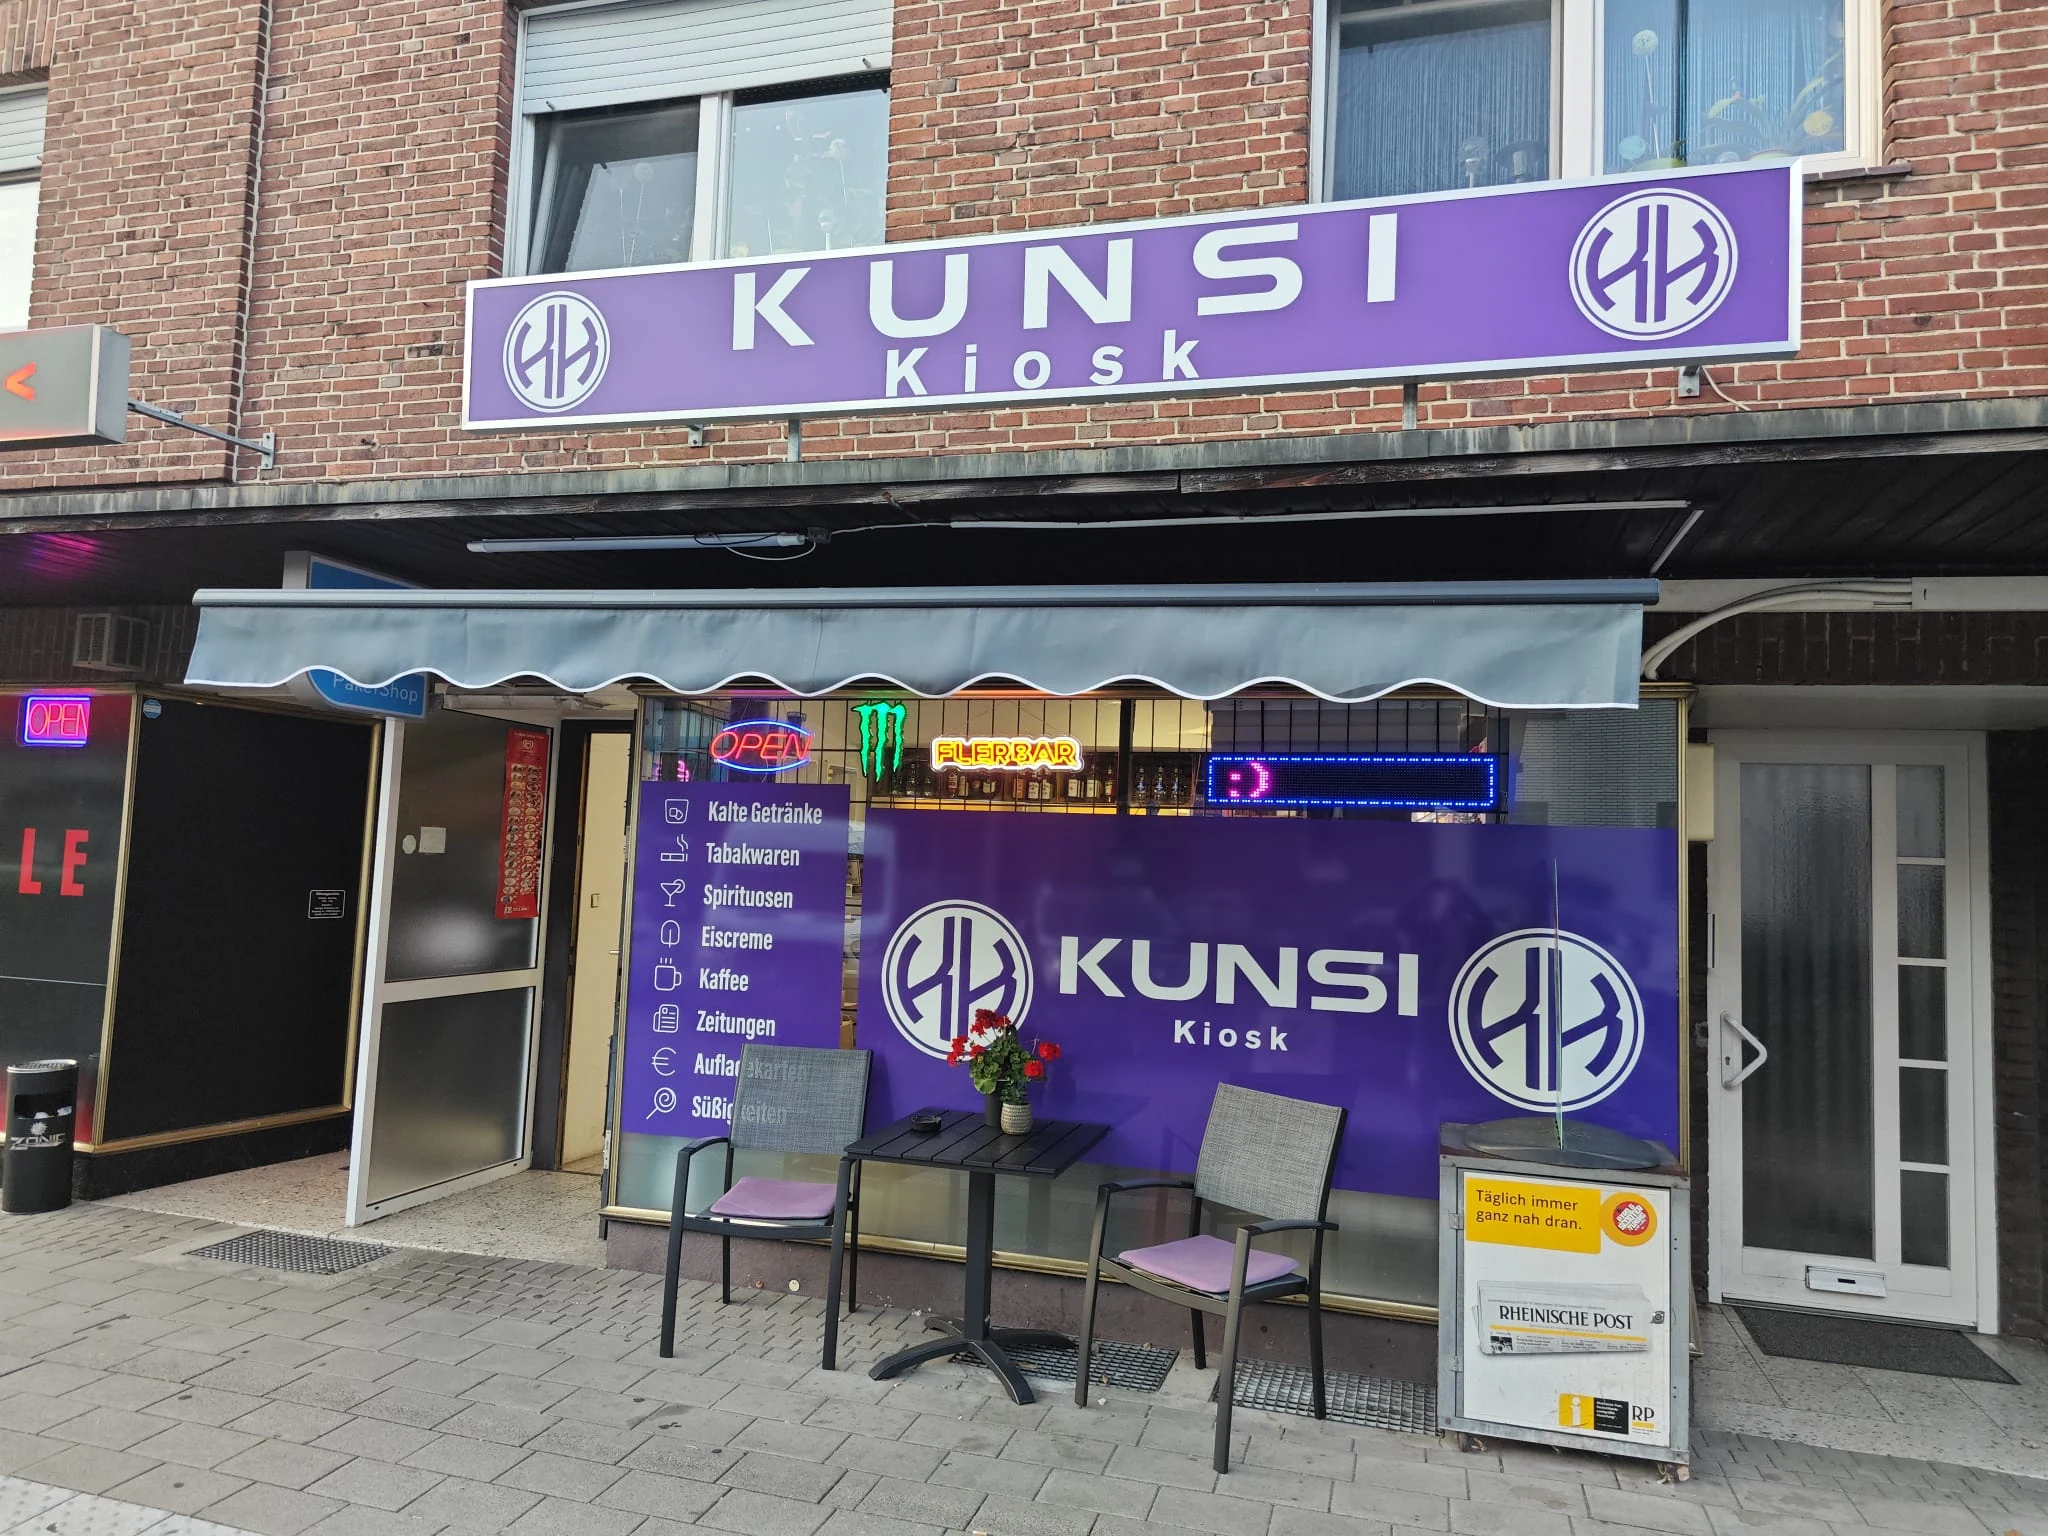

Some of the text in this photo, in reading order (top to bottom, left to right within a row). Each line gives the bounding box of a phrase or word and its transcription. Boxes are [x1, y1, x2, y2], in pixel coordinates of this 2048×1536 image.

[732, 212, 1398, 351] KUNSI
[885, 329, 1200, 398] Kiosk
[28, 703, 89, 737] OPEN
[711, 731, 813, 760] OPEN
[935, 740, 1078, 767] FLERBAR
[708, 800, 823, 825] Kalte Getränke
[706, 842, 800, 866] Tabakwaren
[703, 884, 793, 910] Spirituosen
[701, 925, 773, 950] Eiscreme
[699, 968, 749, 992] Kaffee
[1059, 935, 1420, 1017] KUNSI
[696, 1010, 776, 1040] Zeitungen
[1174, 1019, 1289, 1051] Kiosk
[1476, 1189, 1579, 1211] Täglich immer
[1476, 1210, 1583, 1230] ganz nah dran.
[1499, 1305, 1589, 1327] RHEINISCHE
[1594, 1313, 1634, 1330] POST
[1632, 1405, 1655, 1421] RP
